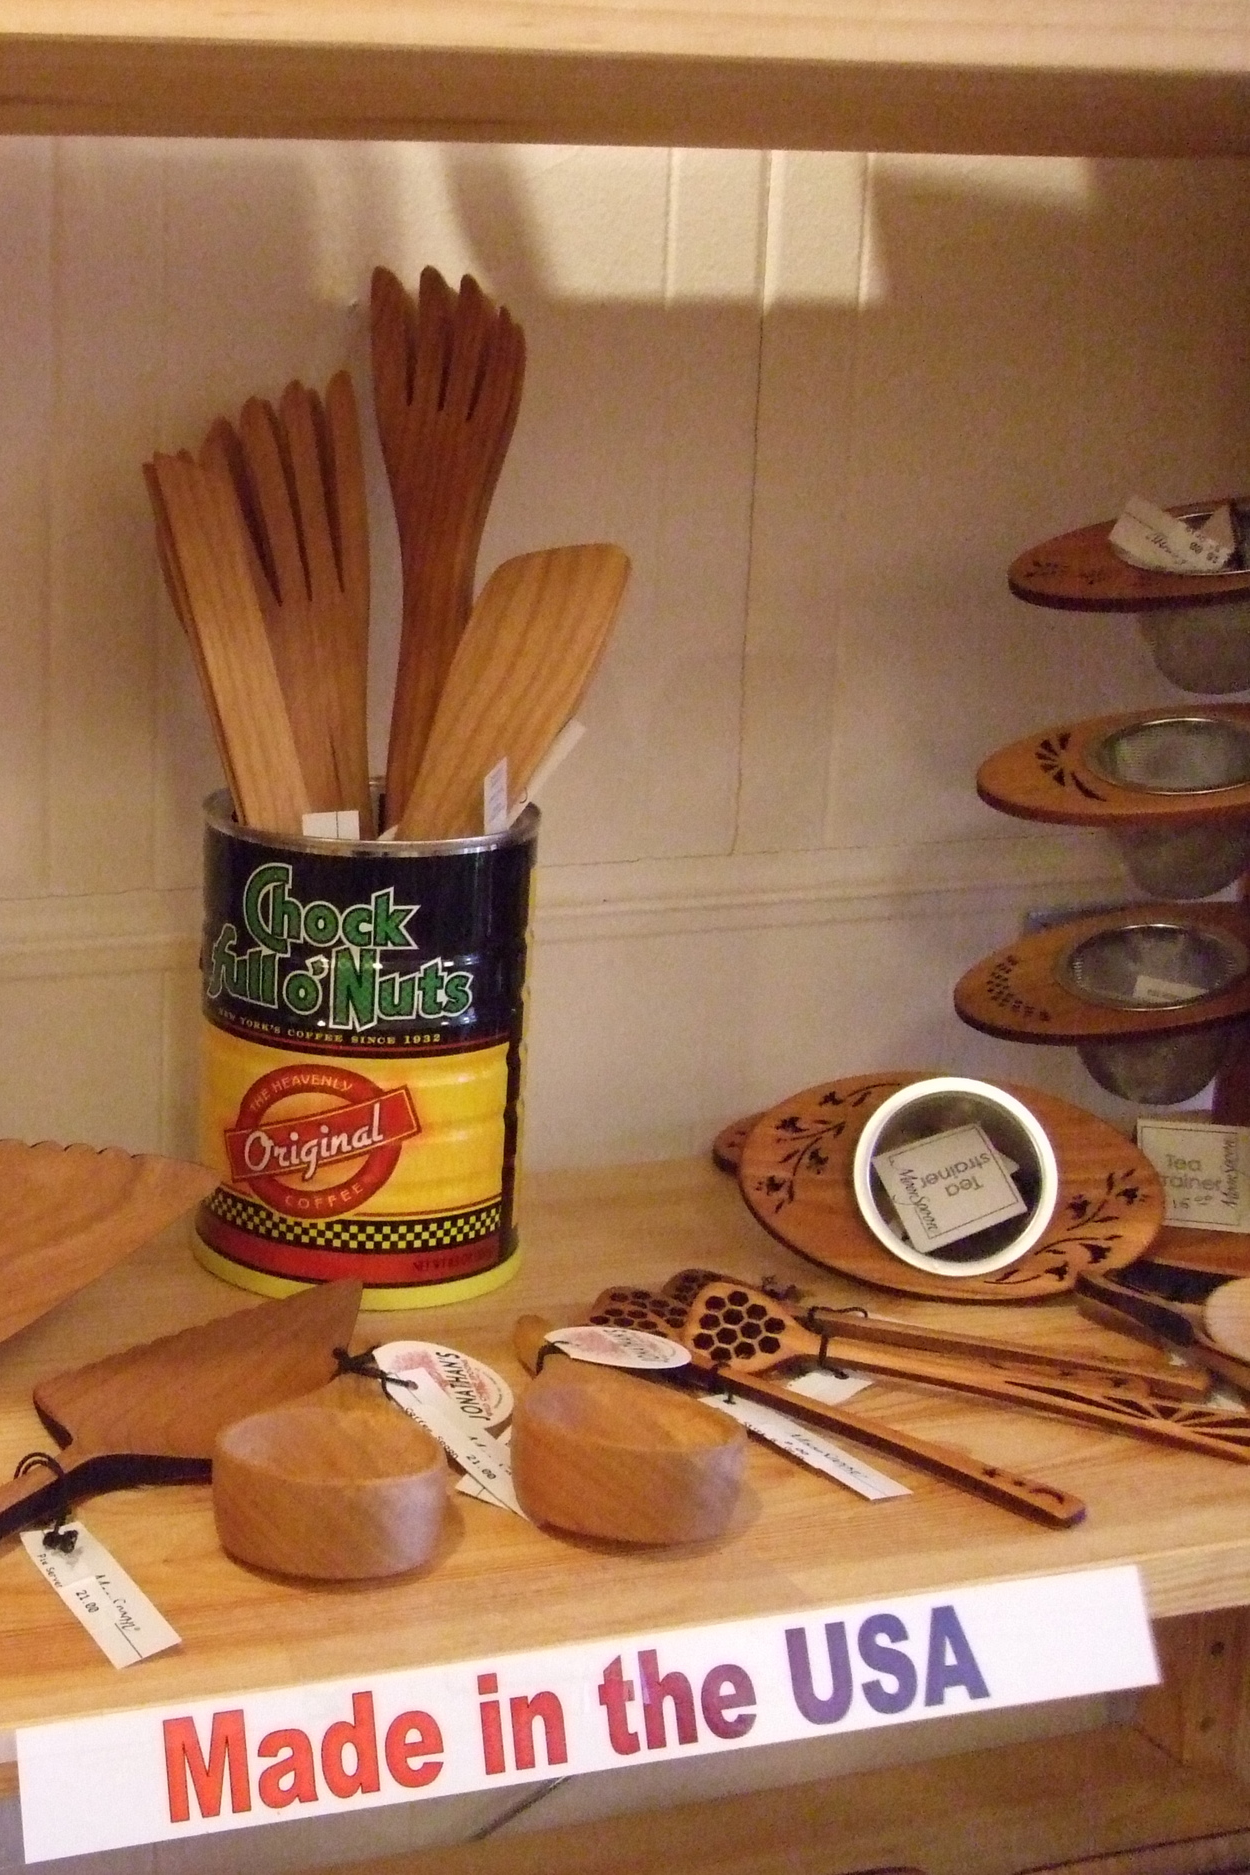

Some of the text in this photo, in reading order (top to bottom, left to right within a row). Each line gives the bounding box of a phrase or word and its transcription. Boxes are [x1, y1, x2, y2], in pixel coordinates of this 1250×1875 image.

[243, 862, 421, 955] Chock
[207, 923, 278, 1009] full
[240, 1017, 281, 1034] YORK'S
[287, 1028, 343, 1043] COFFEE
[351, 1035, 396, 1045] SINCE
[404, 1034, 441, 1045] 1932
[250, 1074, 353, 1111] THE HEAVENLY
[244, 1102, 384, 1180] Original
[920, 1153, 990, 1188] strainer
[1166, 1154, 1201, 1171] Tea
[285, 1182, 364, 1209] COFFEE
[945, 1176, 984, 1197] Tea
[1160, 1174, 1221, 1191] rainer
[435, 1351, 491, 1421] JONATHAN'S
[466, 1454, 497, 1480] 21.00
[46, 1567, 63, 1588] Server
[75, 1589, 100, 1613] 21.00
[162, 1605, 991, 1823] Made in the USA
